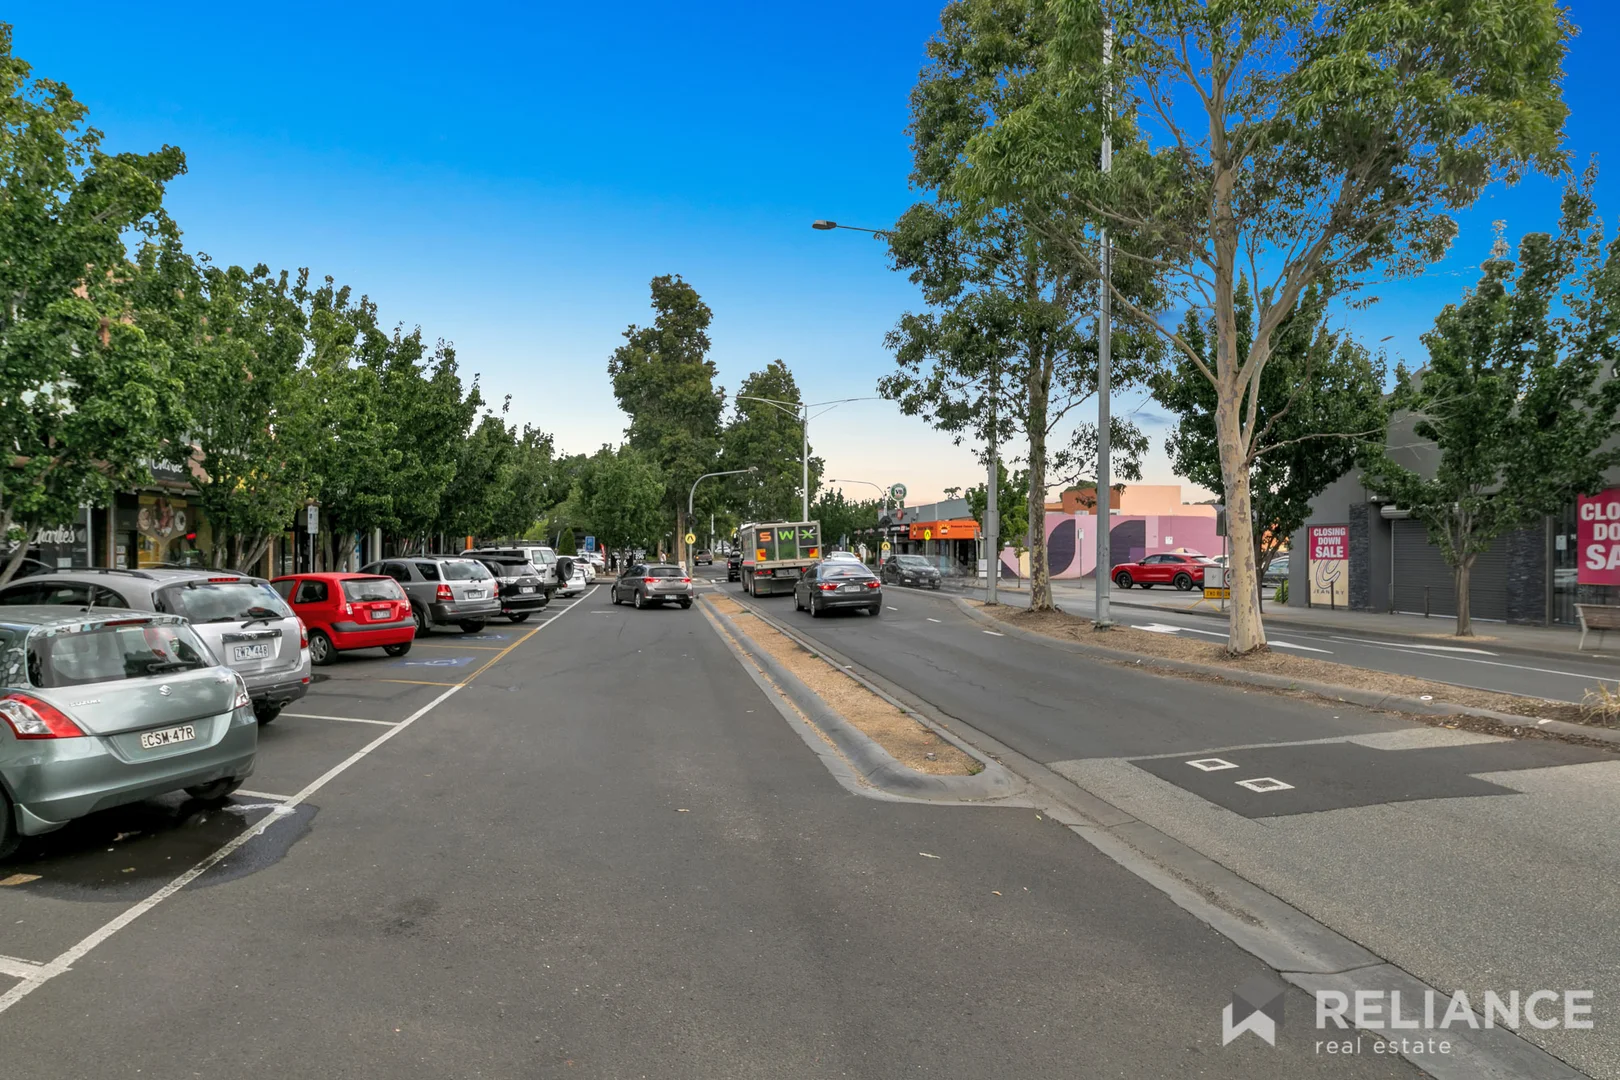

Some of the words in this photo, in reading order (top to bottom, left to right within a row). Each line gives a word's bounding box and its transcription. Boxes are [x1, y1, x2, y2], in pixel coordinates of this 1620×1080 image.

[1313, 527, 1346, 537] CLOSING
[1317, 536, 1341, 545] DOWN
[1315, 546, 1344, 558] SALE
